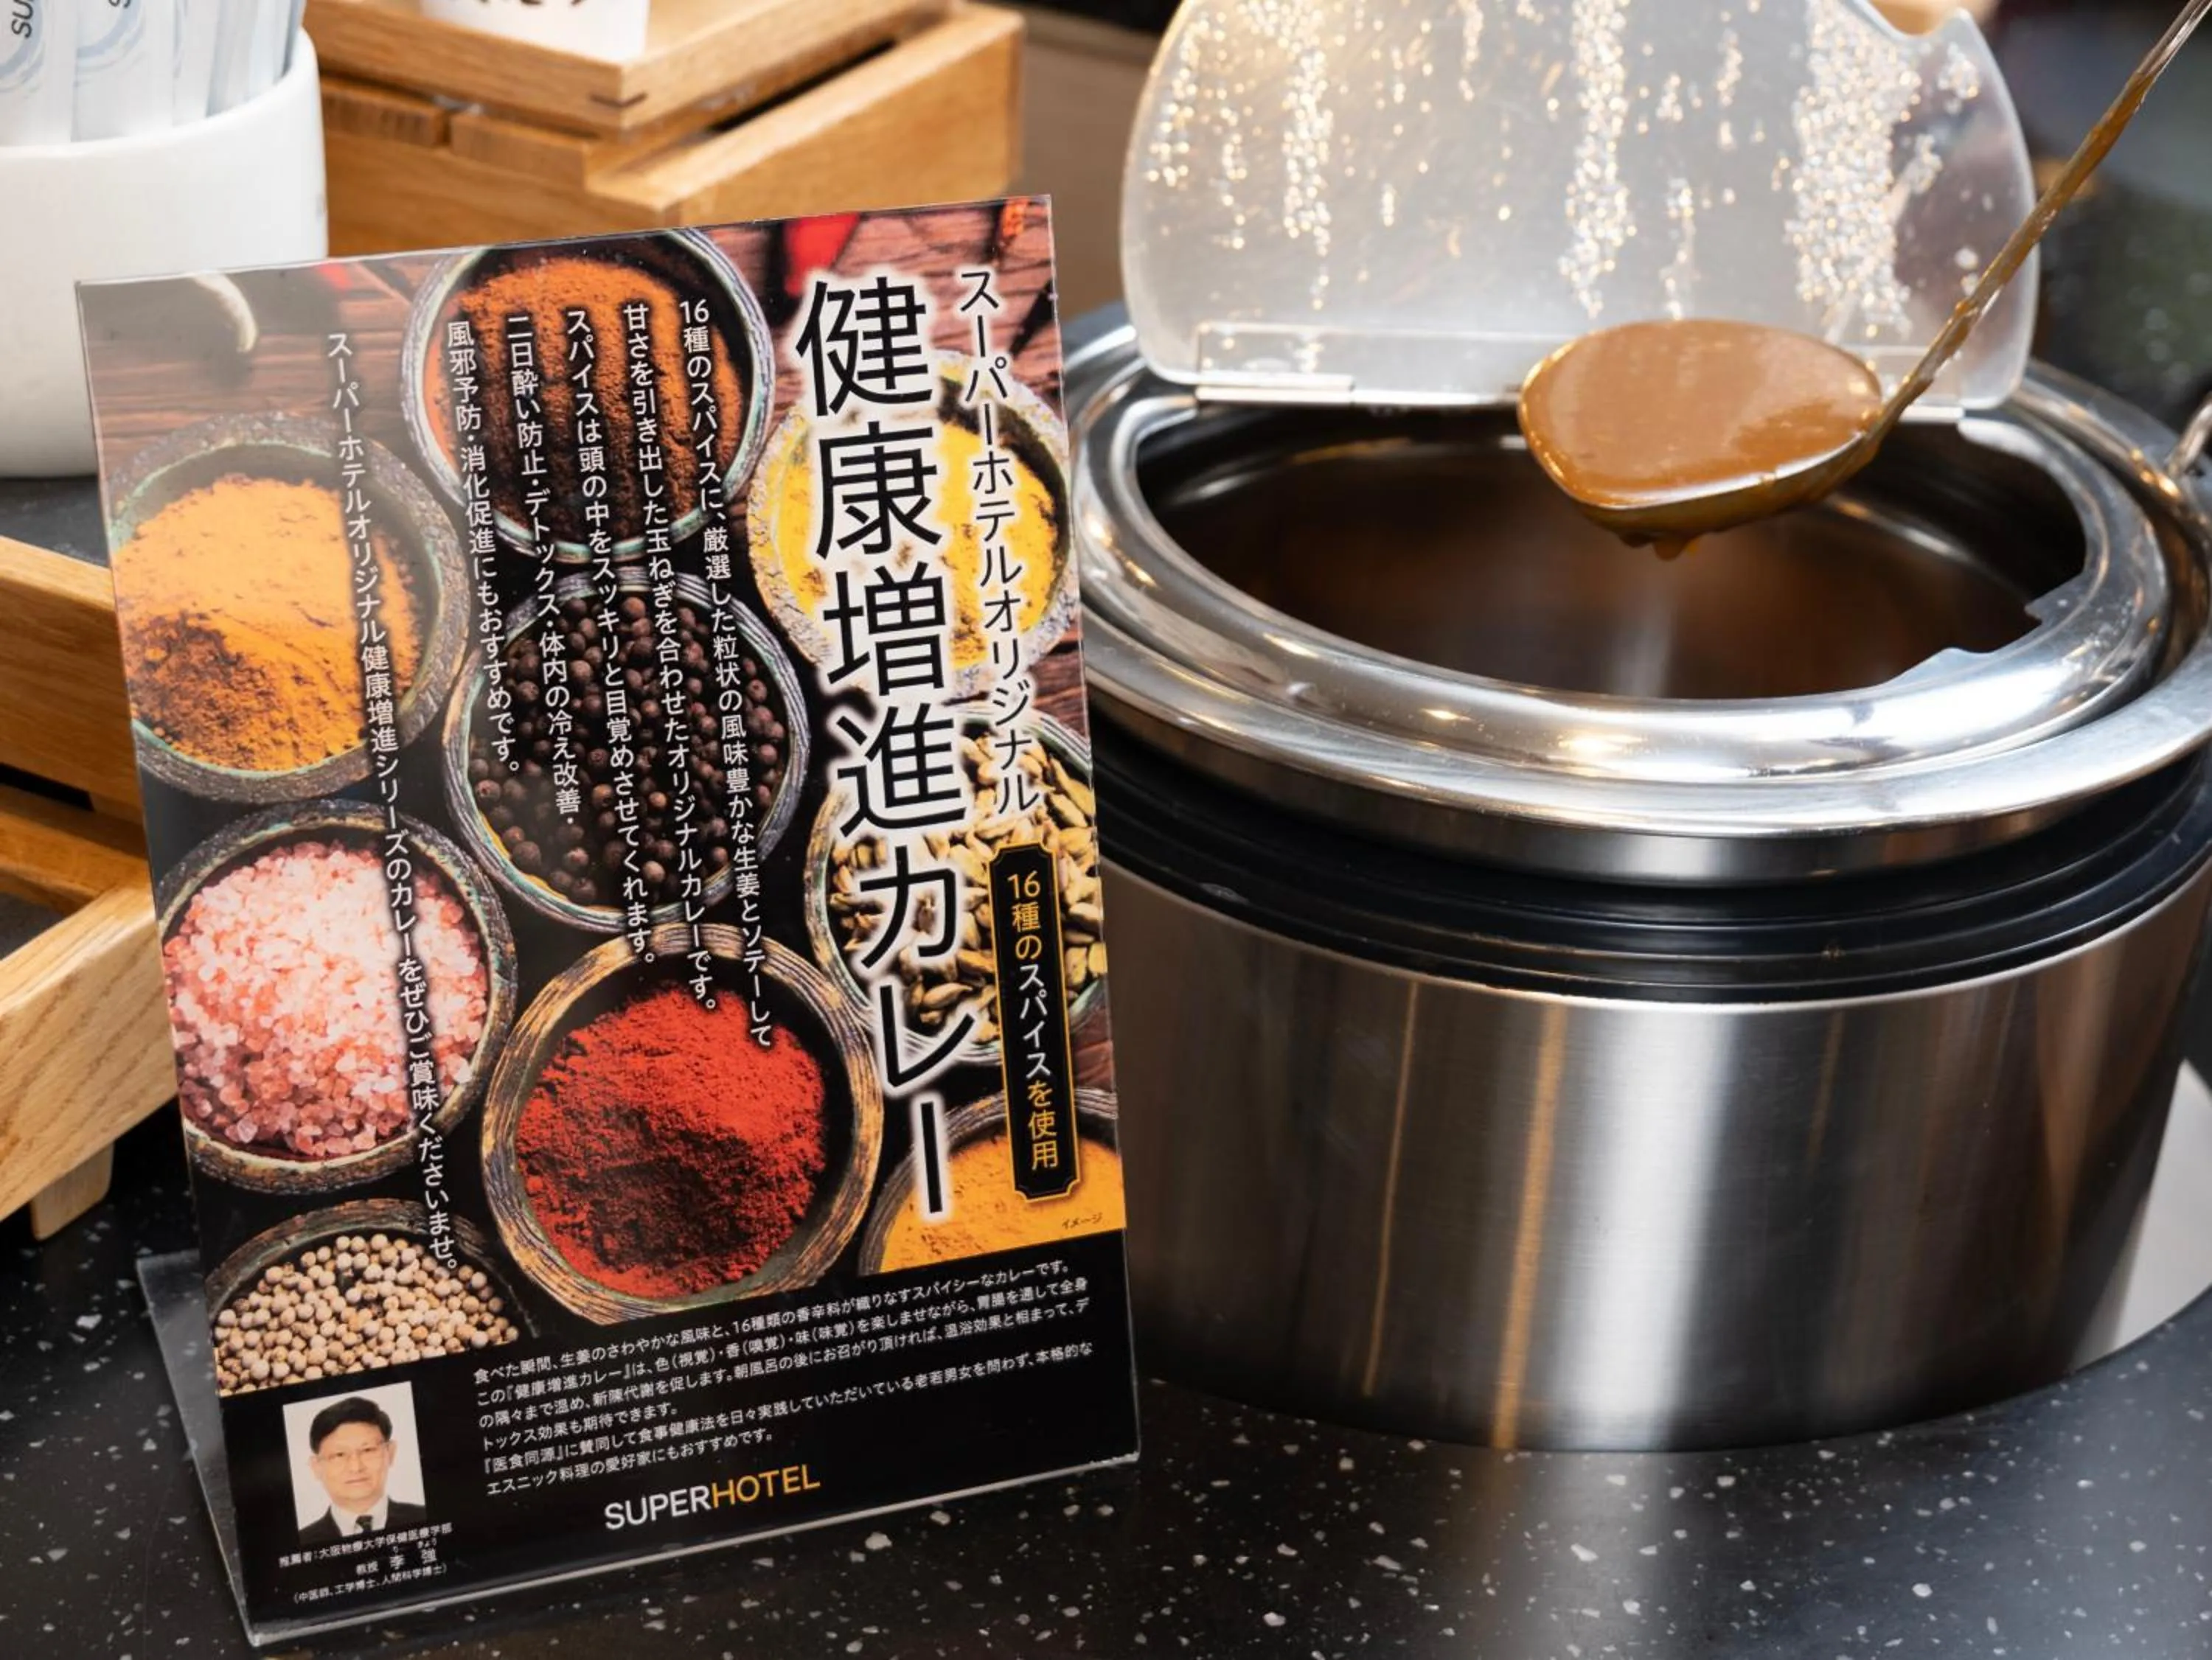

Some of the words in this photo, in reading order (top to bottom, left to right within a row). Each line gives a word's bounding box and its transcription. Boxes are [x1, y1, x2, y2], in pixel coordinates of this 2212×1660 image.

[324, 332, 458, 1272] スーパーホテルオリジナル健康増進シリーズのカレーをぜひご賞味くださいませ。
[445, 321, 520, 775] 風邪予防・消化促進にもおすすめです。
[565, 310, 655, 966] スパイスは頭の中をスッキリと目覚めさせてくれます。
[623, 303, 716, 1014] 甘さを引き出した玉ねぎを合わせたオリジナルカレーです。
[680, 298, 776, 1050] 16種のスパイスに、厳選した粒状の風味豊かな生姜とソテーして
[796, 276, 975, 1213] 健康増進カレー
[961, 271, 1039, 814] スーパーホテルオリジナル
[1007, 870, 1060, 1171] 16種のスパイスを使用
[483, 1399, 678, 1452] トックス効果も期待できます。
